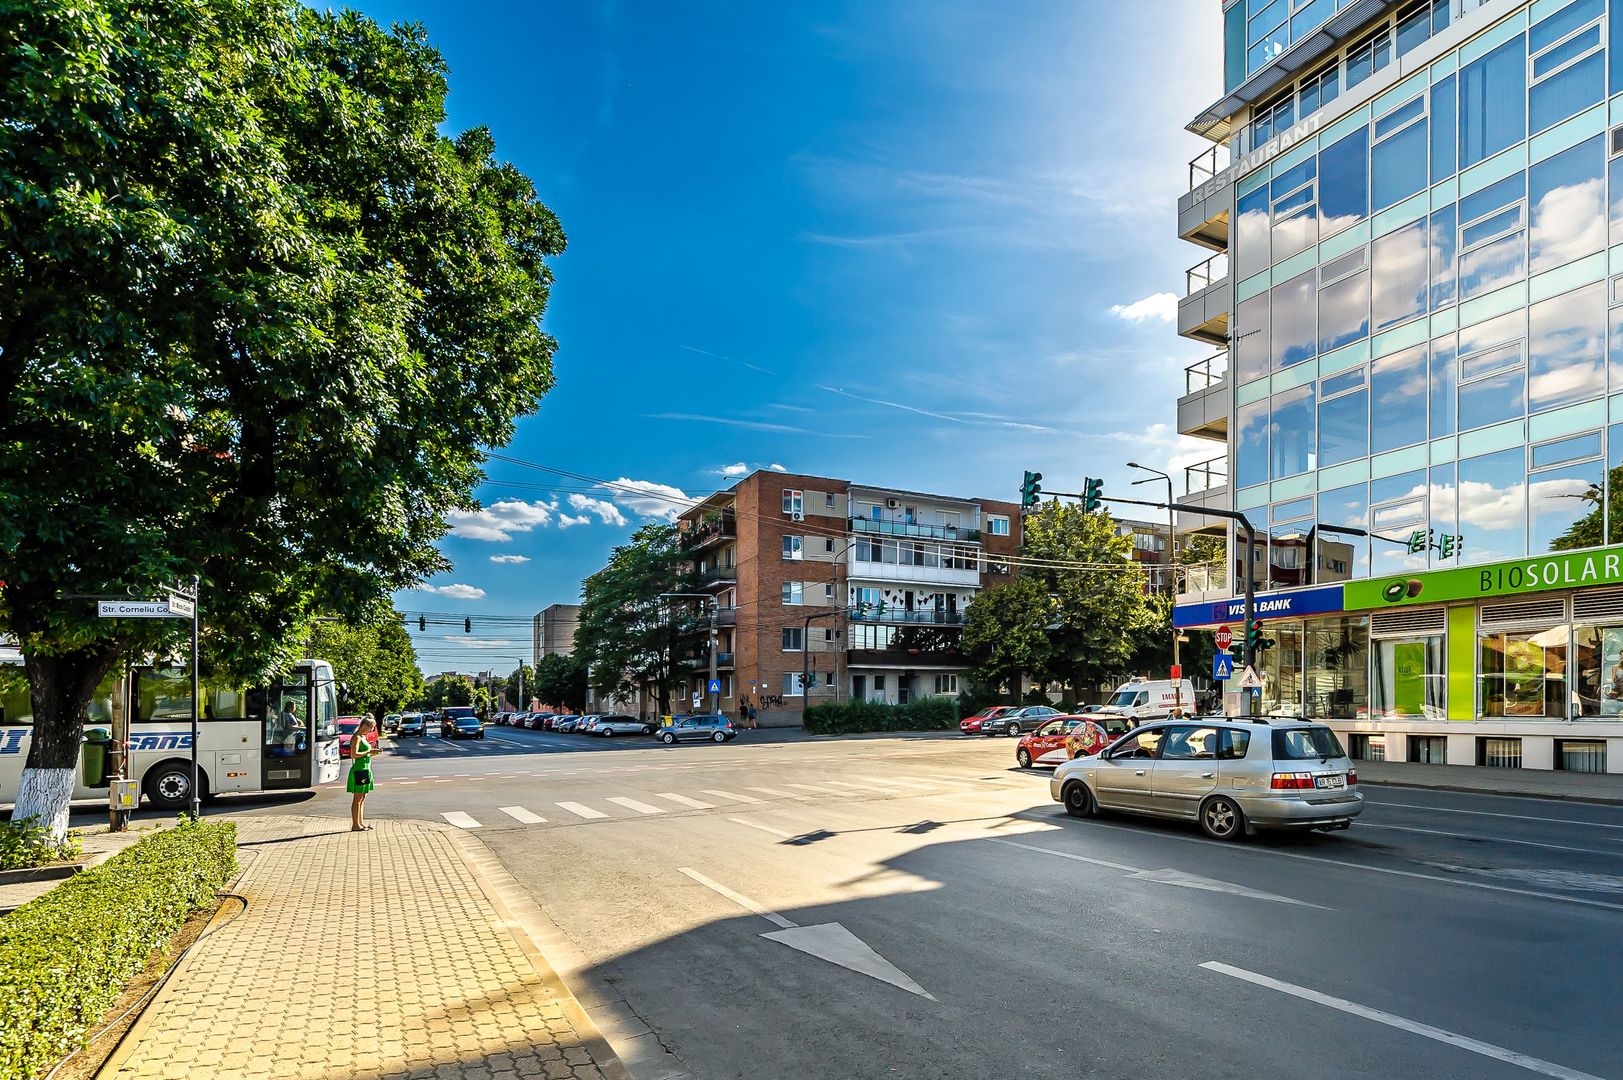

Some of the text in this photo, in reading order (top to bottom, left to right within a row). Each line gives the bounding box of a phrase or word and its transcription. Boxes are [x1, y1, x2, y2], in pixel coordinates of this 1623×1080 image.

[1192, 112, 1324, 206] RESTAURANT
[1480, 554, 1620, 592] BIOSOLAR
[102, 605, 117, 613] Str.
[119, 605, 155, 613] Corneliu
[1229, 599, 1292, 615] VISA BANK
[1216, 632, 1232, 643] STOP
